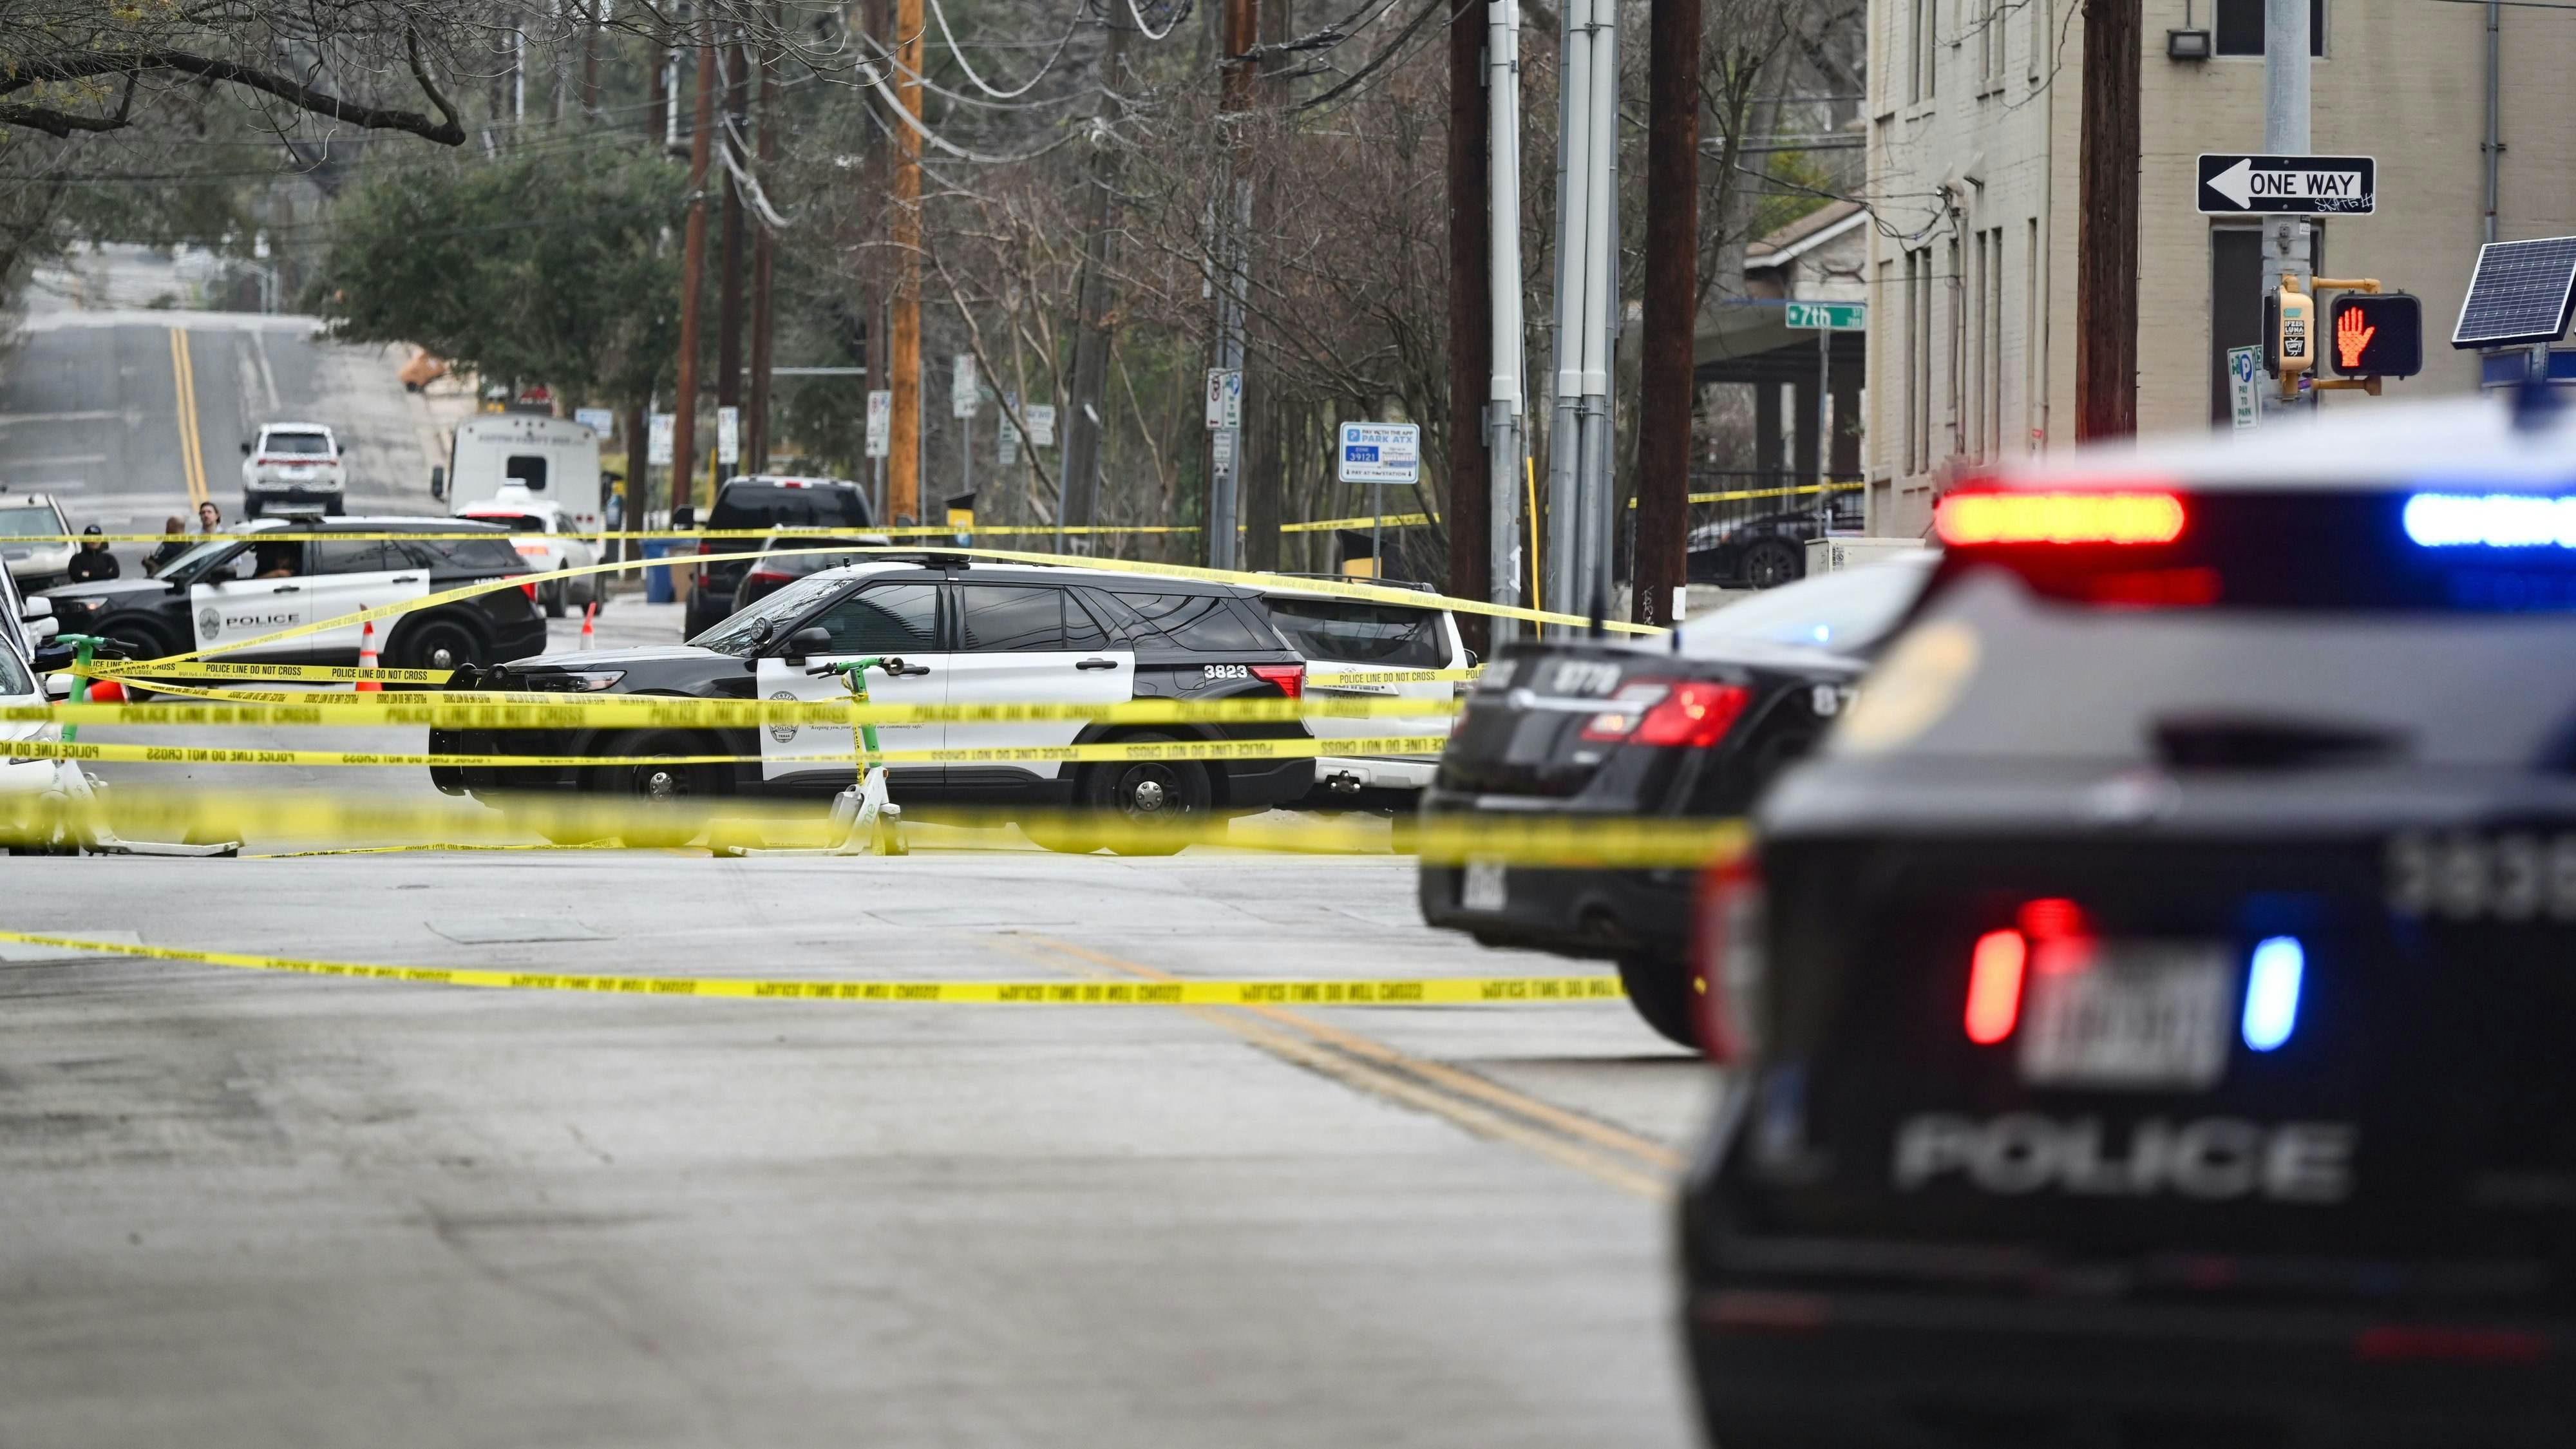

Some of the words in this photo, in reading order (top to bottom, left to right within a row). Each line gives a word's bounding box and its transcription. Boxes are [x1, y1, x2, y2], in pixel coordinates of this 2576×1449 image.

[2251, 173, 2297, 194] ONE
[2306, 174, 2354, 195] WAY
[1799, 305, 1831, 326] 7th
[2239, 386, 2248, 394] PAY
[2241, 397, 2248, 405] TO
[2238, 408, 2251, 417] PARK
[1349, 453, 1376, 461] 39121
[227, 614, 300, 626] POLICE
[232, 665, 248, 674] LINE
[262, 666, 276, 674] NOT
[279, 667, 301, 676] CROSS
[332, 668, 355, 677] POLICE
[359, 669, 374, 678] LINE
[376, 670, 385, 679] DO
[388, 670, 402, 679] NOT
[404, 670, 427, 680] CROSS
[1204, 665, 1248, 678] 3823
[1466, 670, 1484, 679] POLI
[1340, 674, 1363, 683] POLICE
[1367, 674, 1381, 683] LINE
[1384, 673, 1393, 682] DO
[1396, 672, 1410, 681] NOT
[1412, 671, 1435, 681] CROSS
[304, 694, 317, 703] CROSS
[328, 694, 333, 703] DO
[334, 694, 343, 703] LINE
[345, 694, 358, 703] POLICE
[376, 694, 388, 703] CROSS
[399, 694, 403, 703] DO
[414, 694, 426, 703] POLICE
[1192, 745, 1205, 757] DO
[1209, 744, 1233, 757] LINE
[1237, 743, 1274, 756] POLICE
[1321, 741, 1356, 754] CROSS
[1362, 741, 1381, 753] NOT
[1386, 740, 1400, 752] DO
[1405, 739, 1427, 752] LINE
[932, 752, 967, 761] CROSS
[971, 750, 992, 760] NOT
[997, 750, 1010, 759] DO
[1014, 749, 1037, 759] LINE
[1042, 747, 1078, 759] POLICE
[1127, 746, 1162, 759] CROSS
[1166, 745, 1187, 758] NOT
[1895, 1112, 2355, 1203] POLICE
